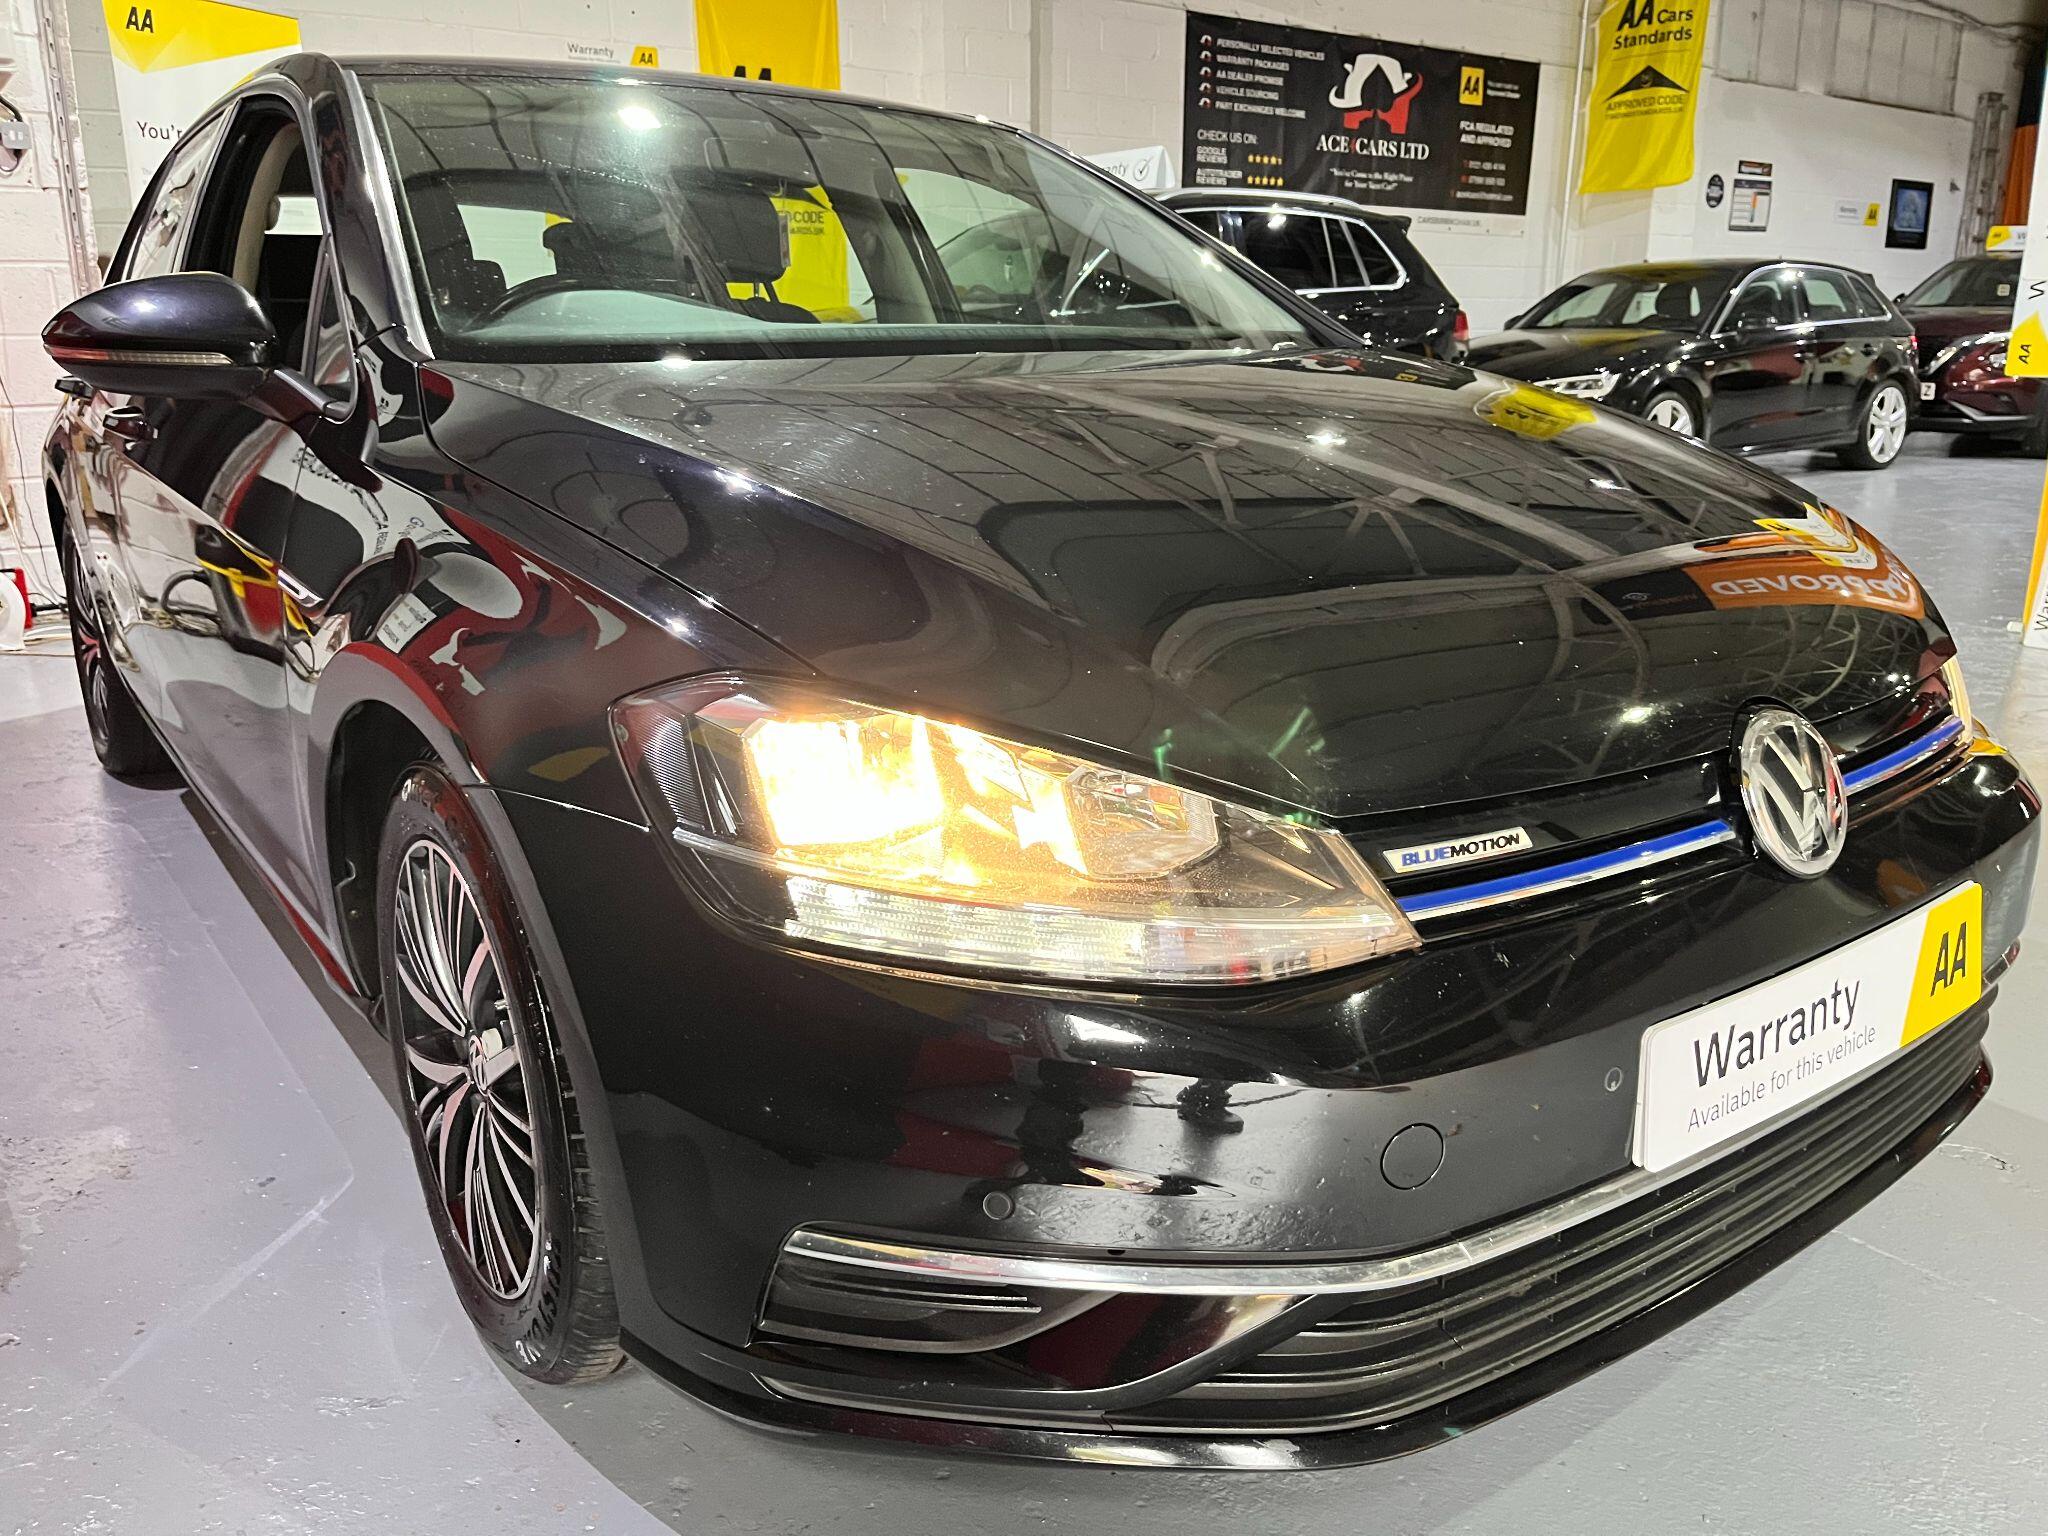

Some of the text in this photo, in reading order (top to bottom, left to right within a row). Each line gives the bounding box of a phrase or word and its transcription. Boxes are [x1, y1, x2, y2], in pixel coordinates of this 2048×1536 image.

[126, 7, 154, 33] AA
[1617, 0, 1694, 31] AA Cars
[567, 42, 614, 59] Warranty
[1612, 26, 1693, 50] Standards
[639, 52, 653, 64] AA
[1462, 75, 1480, 96] AA
[1197, 128, 1229, 142] CHECK
[1229, 132, 1243, 143] US
[1316, 134, 1430, 160] ACE CARS LTD
[793, 210, 824, 223] CODE
[2018, 343, 2032, 364] AA
[1401, 832, 1520, 867] BLUEMOTION
[1930, 921, 1967, 997] AA
[1693, 977, 1860, 1087] Warranty
[1687, 1024, 1876, 1133] Available for this vehicle
